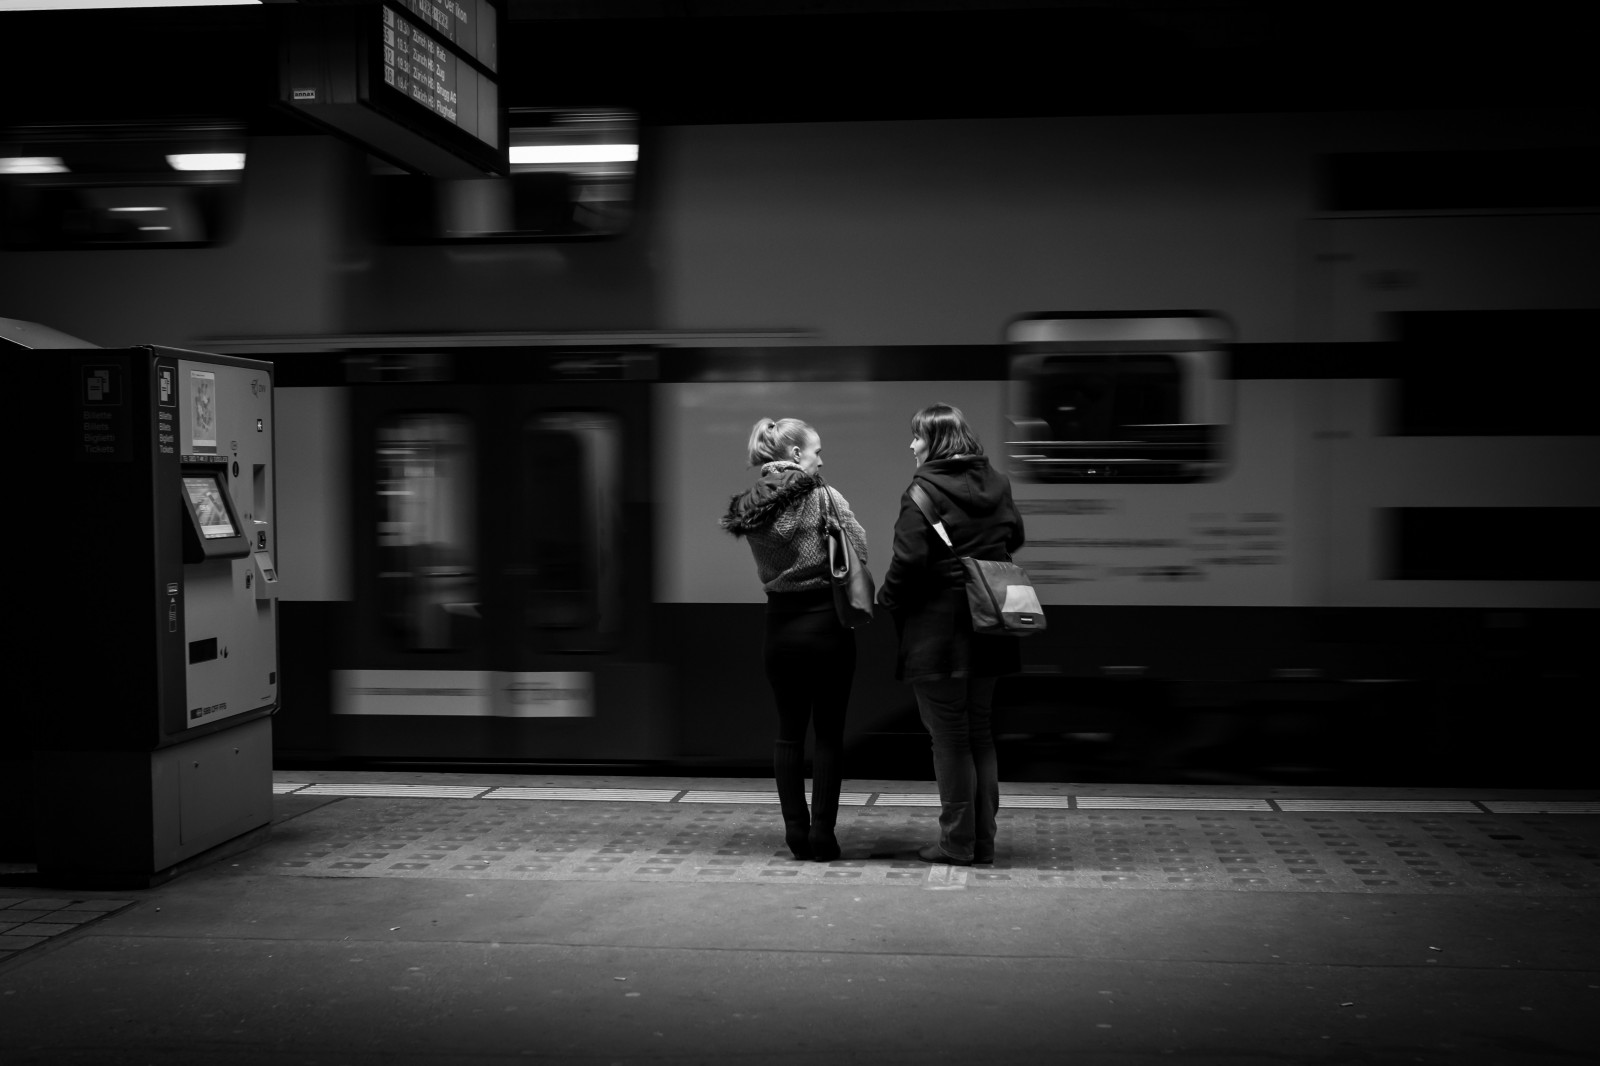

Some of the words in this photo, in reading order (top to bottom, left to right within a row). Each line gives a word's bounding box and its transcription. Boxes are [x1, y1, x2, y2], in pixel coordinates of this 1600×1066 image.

[413, 29, 427, 50] Zürich
[413, 47, 427, 68] Zürich
[436, 64, 446, 82] Zug
[413, 66, 427, 86] Zürich
[436, 82, 450, 103] Brugg
[413, 85, 427, 105] Zürich
[84, 445, 115, 453] Tickets
